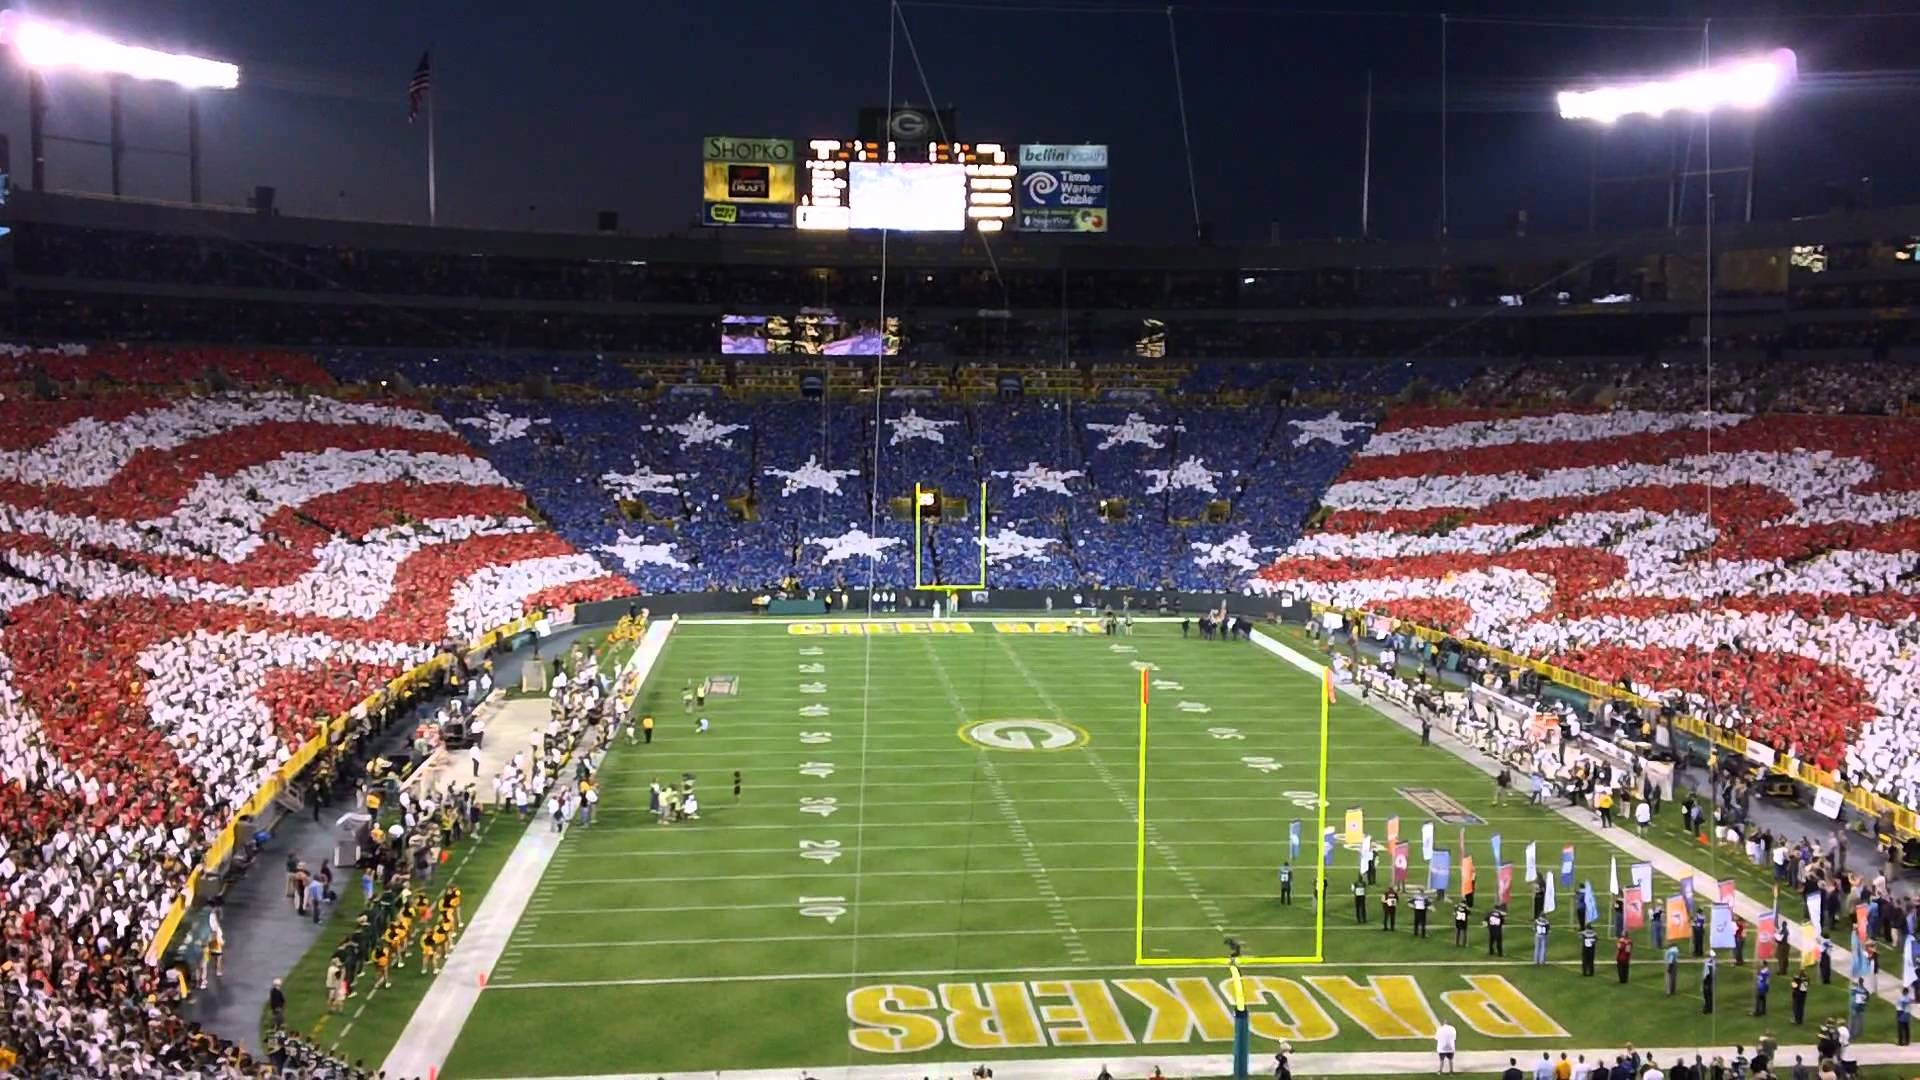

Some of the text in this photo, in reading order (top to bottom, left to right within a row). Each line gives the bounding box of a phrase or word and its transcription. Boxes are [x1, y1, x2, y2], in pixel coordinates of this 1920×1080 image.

[1025, 147, 1065, 161] bellin
[1060, 171, 1092, 182] Time
[1060, 183, 1104, 194] Warner
[1060, 194, 1095, 205] Cable
[969, 719, 1078, 749] G
[799, 797, 839, 814] 30
[799, 840, 842, 859] 20
[798, 896, 847, 917] 10
[846, 974, 1571, 1053] PACKERS
